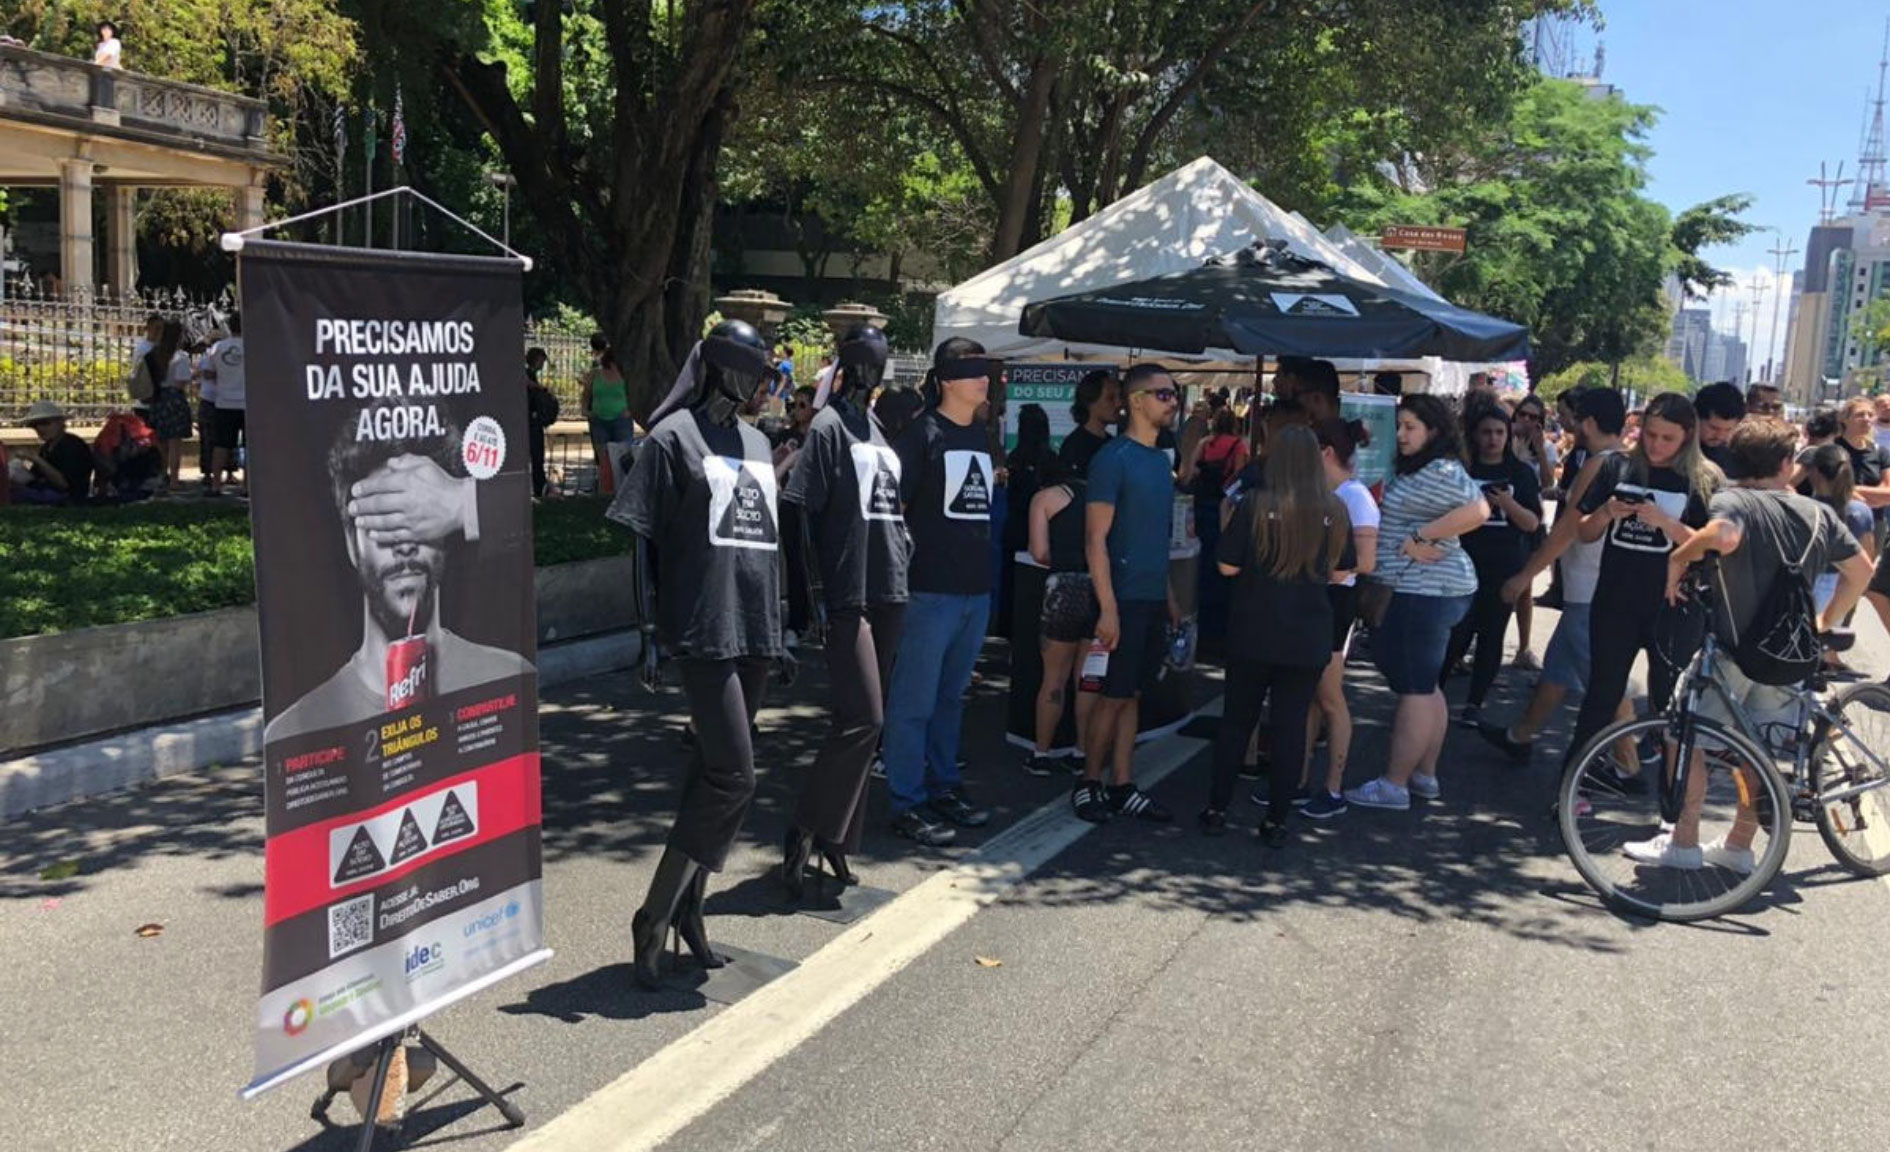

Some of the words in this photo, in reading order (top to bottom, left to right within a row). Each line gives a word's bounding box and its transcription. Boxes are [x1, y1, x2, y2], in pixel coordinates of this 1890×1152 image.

[315, 319, 474, 354] PRECISAMOS
[306, 364, 345, 400] DA
[352, 363, 402, 398] SUA
[408, 362, 481, 396] AJUDA
[1013, 369, 1090, 383] PRECISAM
[1014, 386, 1033, 397] DO
[1037, 387, 1063, 398] SEU
[355, 405, 446, 442] AGORA.
[467, 441, 499, 468] 6/11
[390, 655, 426, 706] Refri
[365, 729, 379, 763] 2
[382, 726, 438, 758] TRIÂNGULOS
[285, 746, 348, 773] PARTICIPE
[463, 906, 504, 937] unicef
[405, 942, 442, 974] idec
